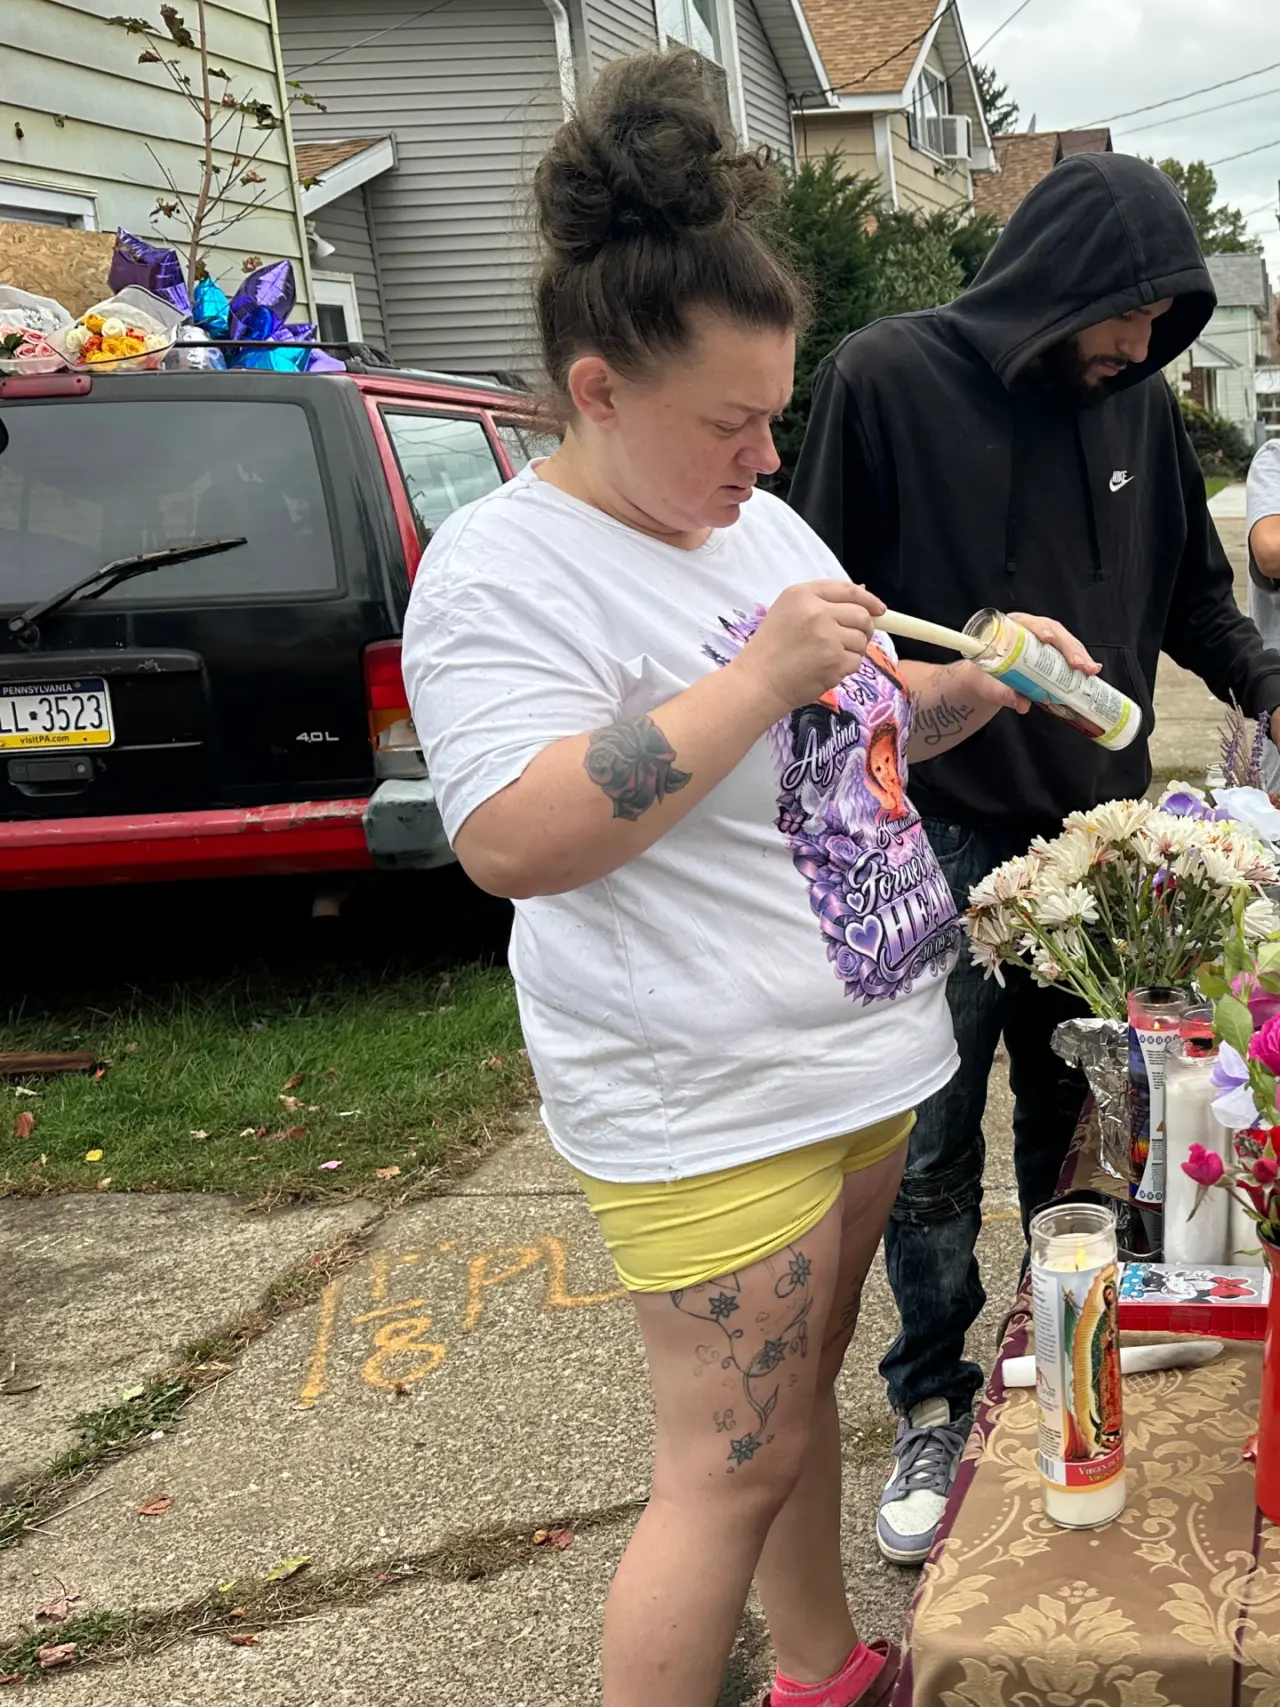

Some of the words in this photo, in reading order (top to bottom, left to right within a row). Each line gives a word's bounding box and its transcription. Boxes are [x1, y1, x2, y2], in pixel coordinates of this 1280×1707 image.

[2, 683, 73, 696] PENNSYLVANIA
[20, 734, 70, 745] visitPA.com
[781, 713, 859, 791] Angelina
[848, 848, 928, 917] Forever
